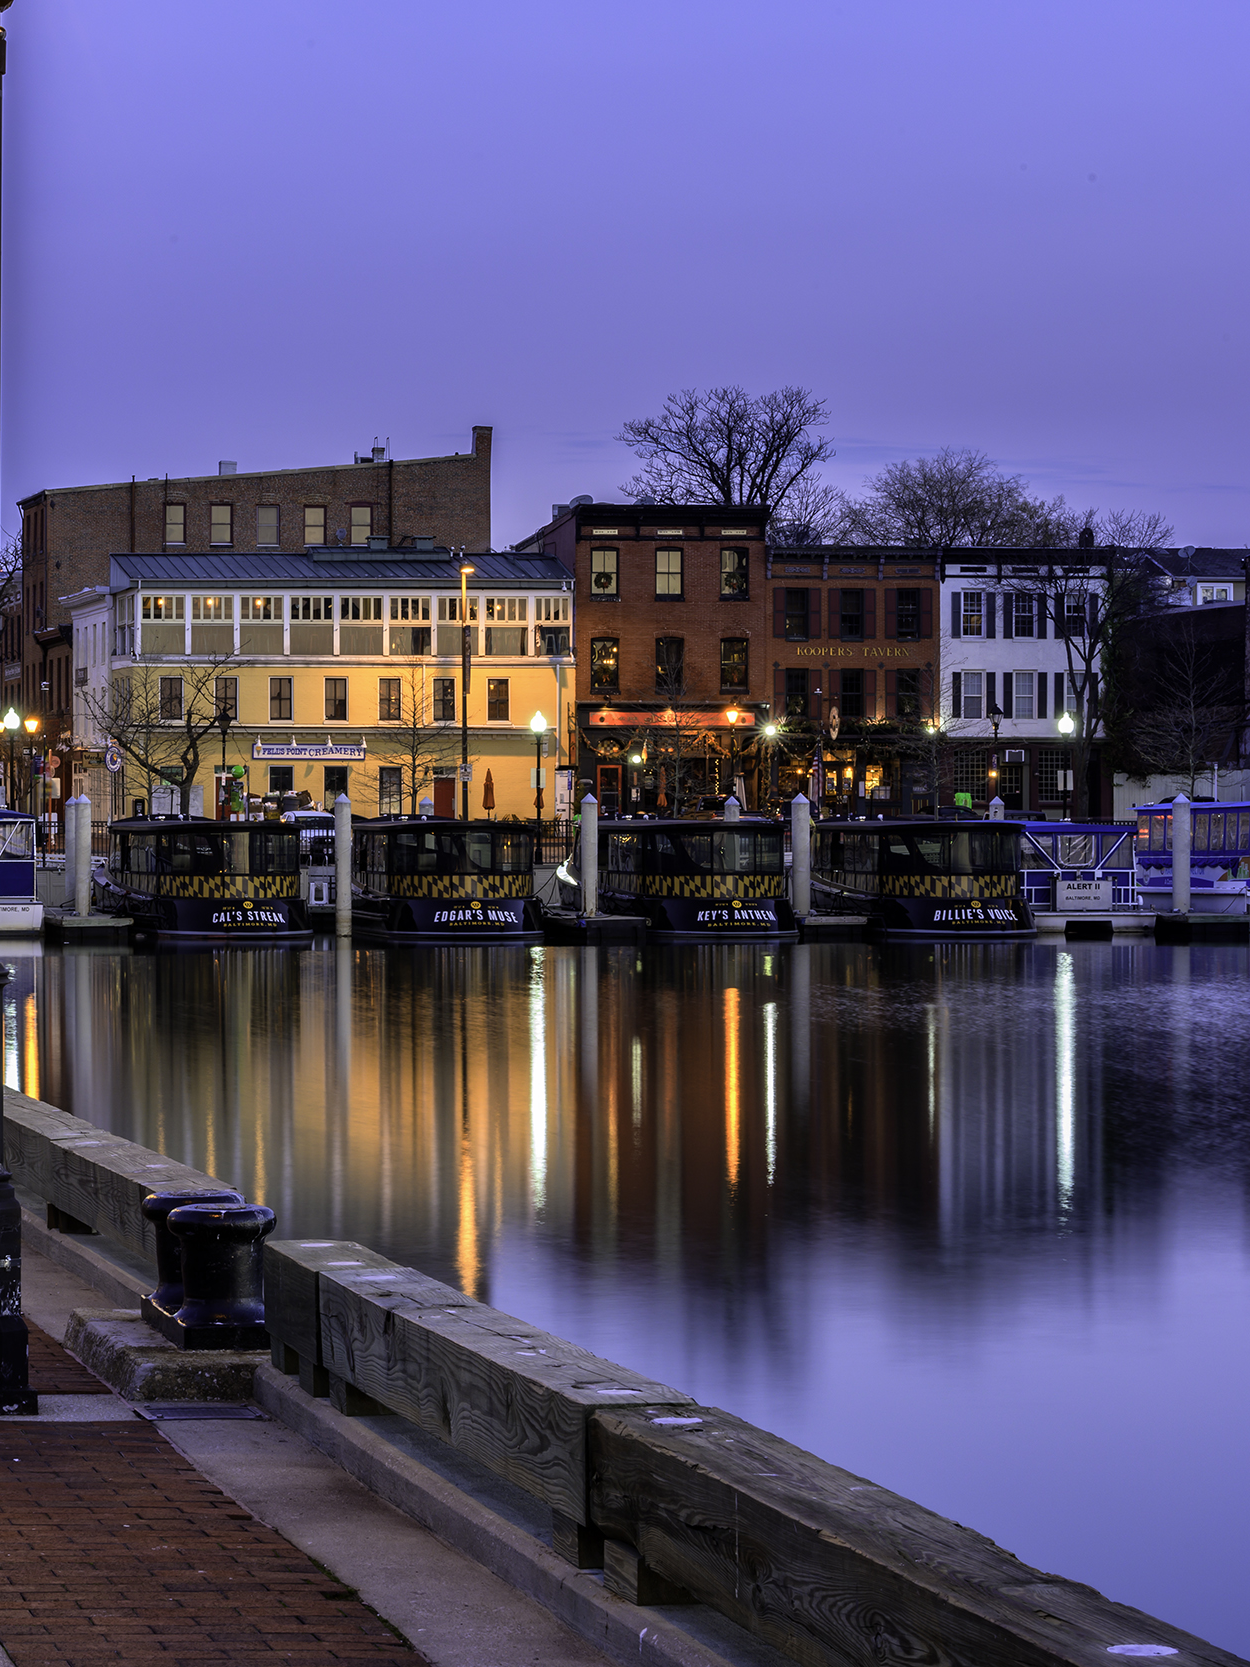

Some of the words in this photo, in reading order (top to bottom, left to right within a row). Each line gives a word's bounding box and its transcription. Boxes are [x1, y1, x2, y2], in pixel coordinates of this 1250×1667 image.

[797, 646, 852, 656] KOOPERS
[862, 647, 910, 657] TAVERN
[309, 746, 363, 757] CREAMERY
[212, 911, 243, 923] CAL'S
[247, 911, 286, 923] STREAK
[434, 910, 483, 923] EDGAR'S
[487, 910, 519, 923] MUSE
[697, 909, 729, 921] KEY'S
[734, 909, 777, 921] ANTHEM
[933, 909, 985, 921] BILLIE'S
[987, 909, 1019, 921] VOICE
